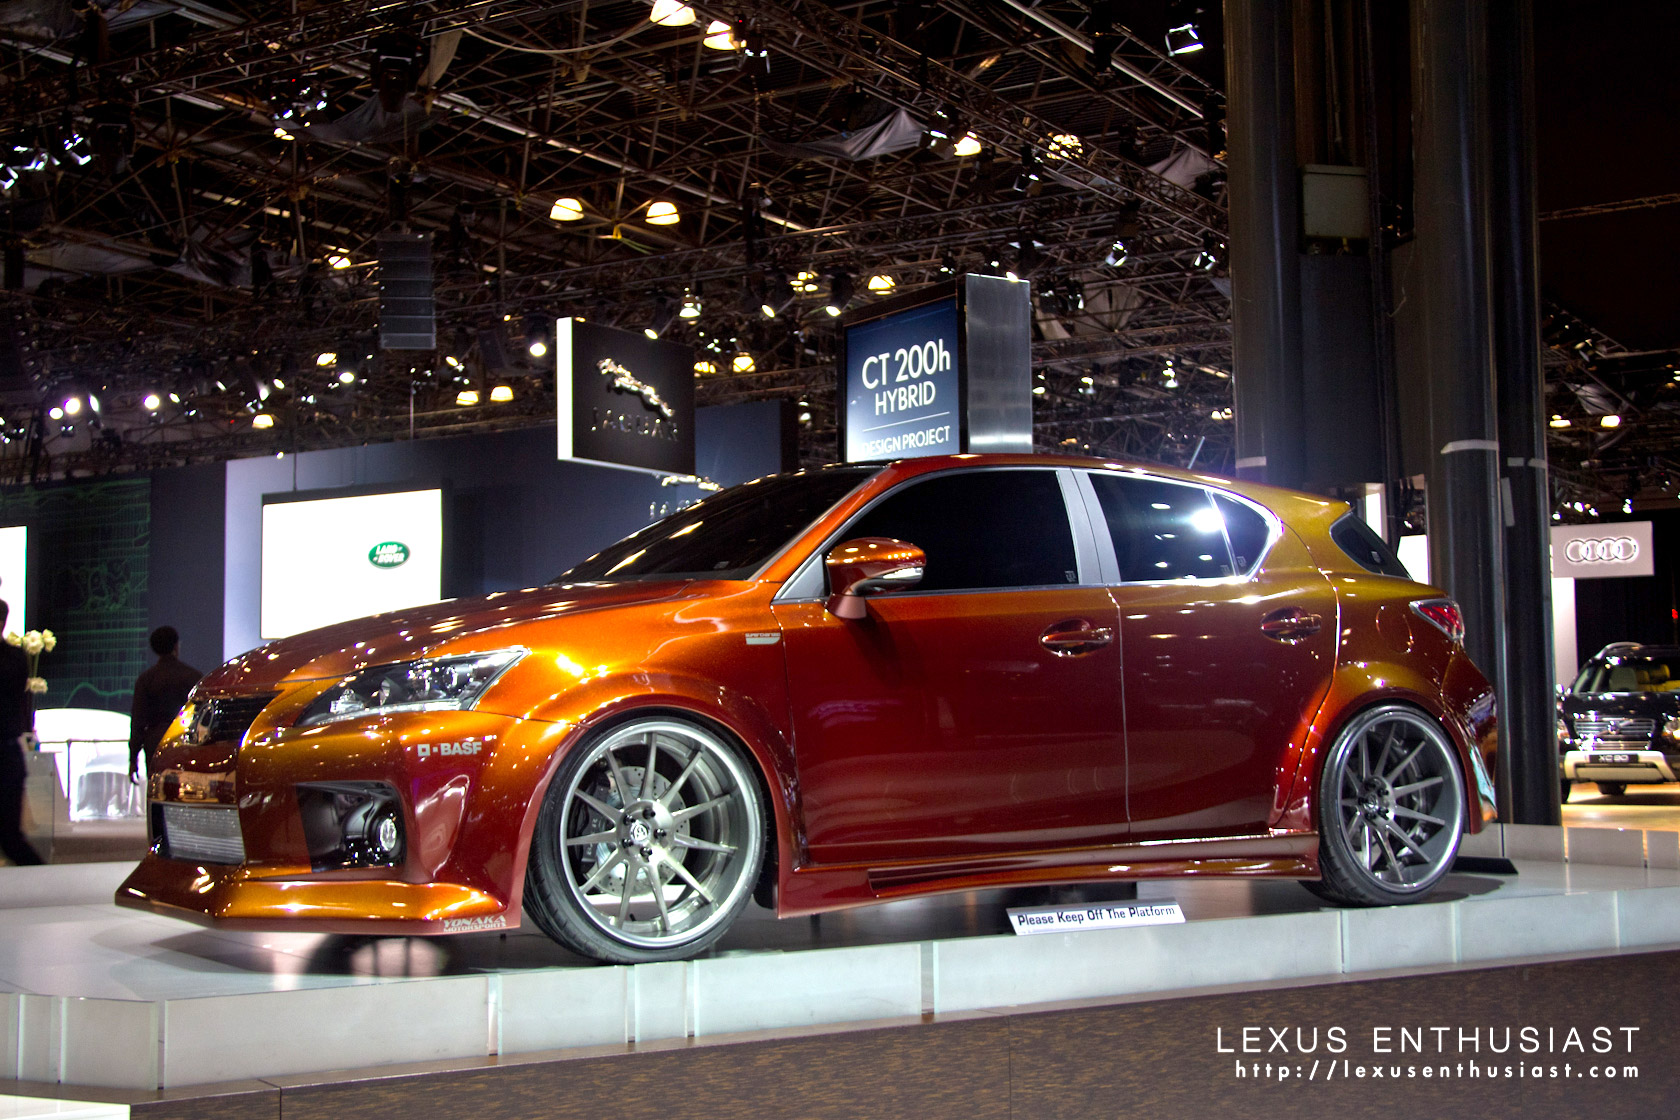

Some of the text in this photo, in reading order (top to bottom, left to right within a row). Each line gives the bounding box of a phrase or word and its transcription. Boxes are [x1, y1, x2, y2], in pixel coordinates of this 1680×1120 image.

[862, 339, 950, 389] CT 200h
[875, 381, 936, 415] HYBRID
[863, 426, 950, 457] DESIGN PROJECT
[440, 742, 482, 756] BASF
[443, 915, 506, 928] YONAKA
[1018, 905, 1175, 926] Please Keep Off The Platform
